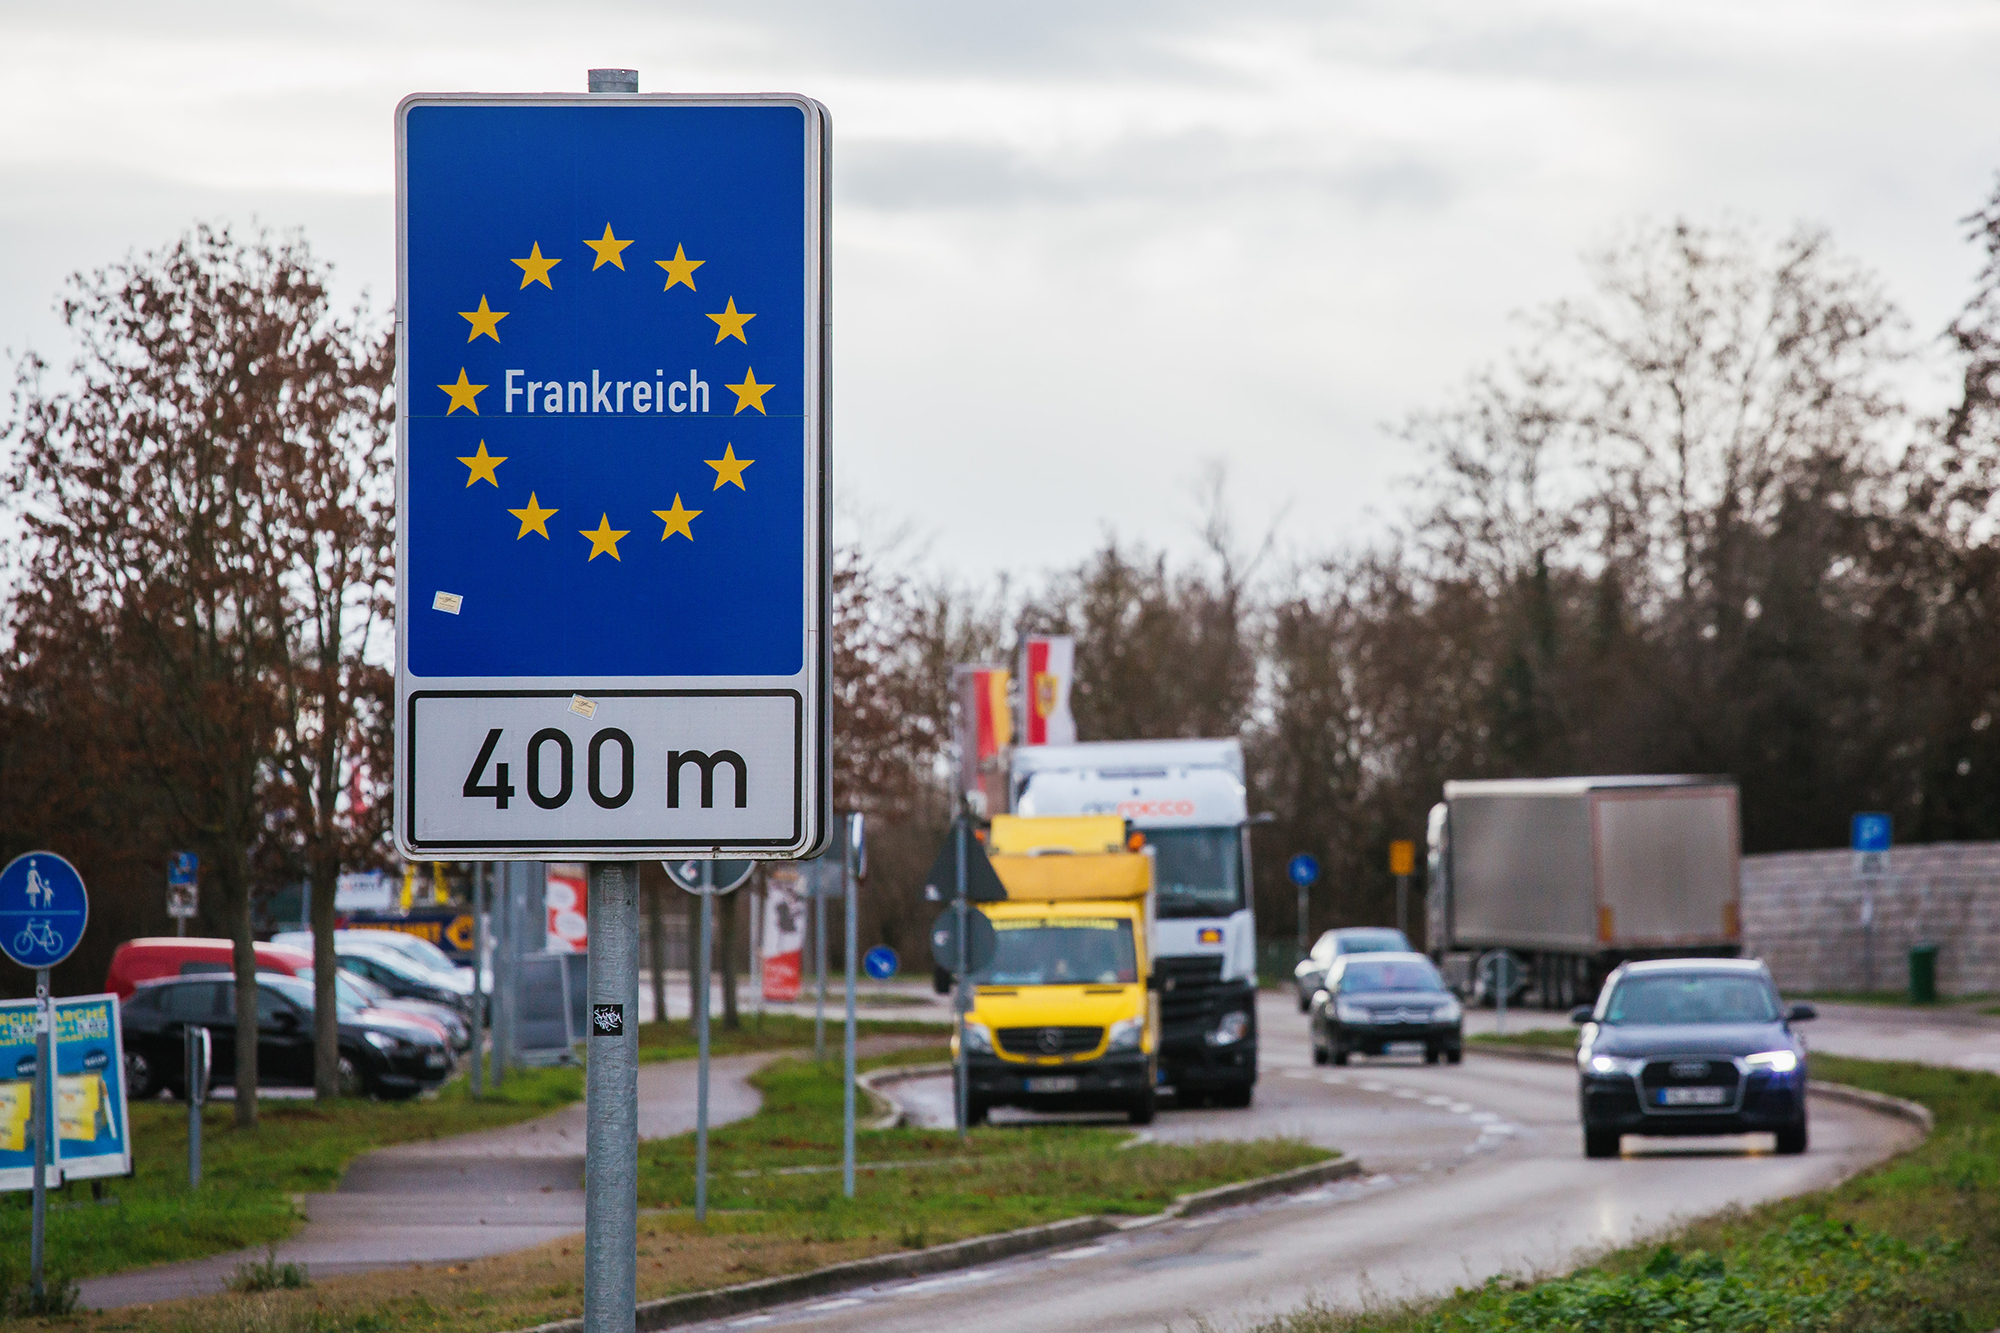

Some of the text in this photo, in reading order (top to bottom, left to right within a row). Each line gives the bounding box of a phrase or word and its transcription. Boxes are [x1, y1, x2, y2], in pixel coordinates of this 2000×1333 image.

[504, 369, 710, 413] Frankreich
[462, 727, 748, 810] 400 m
